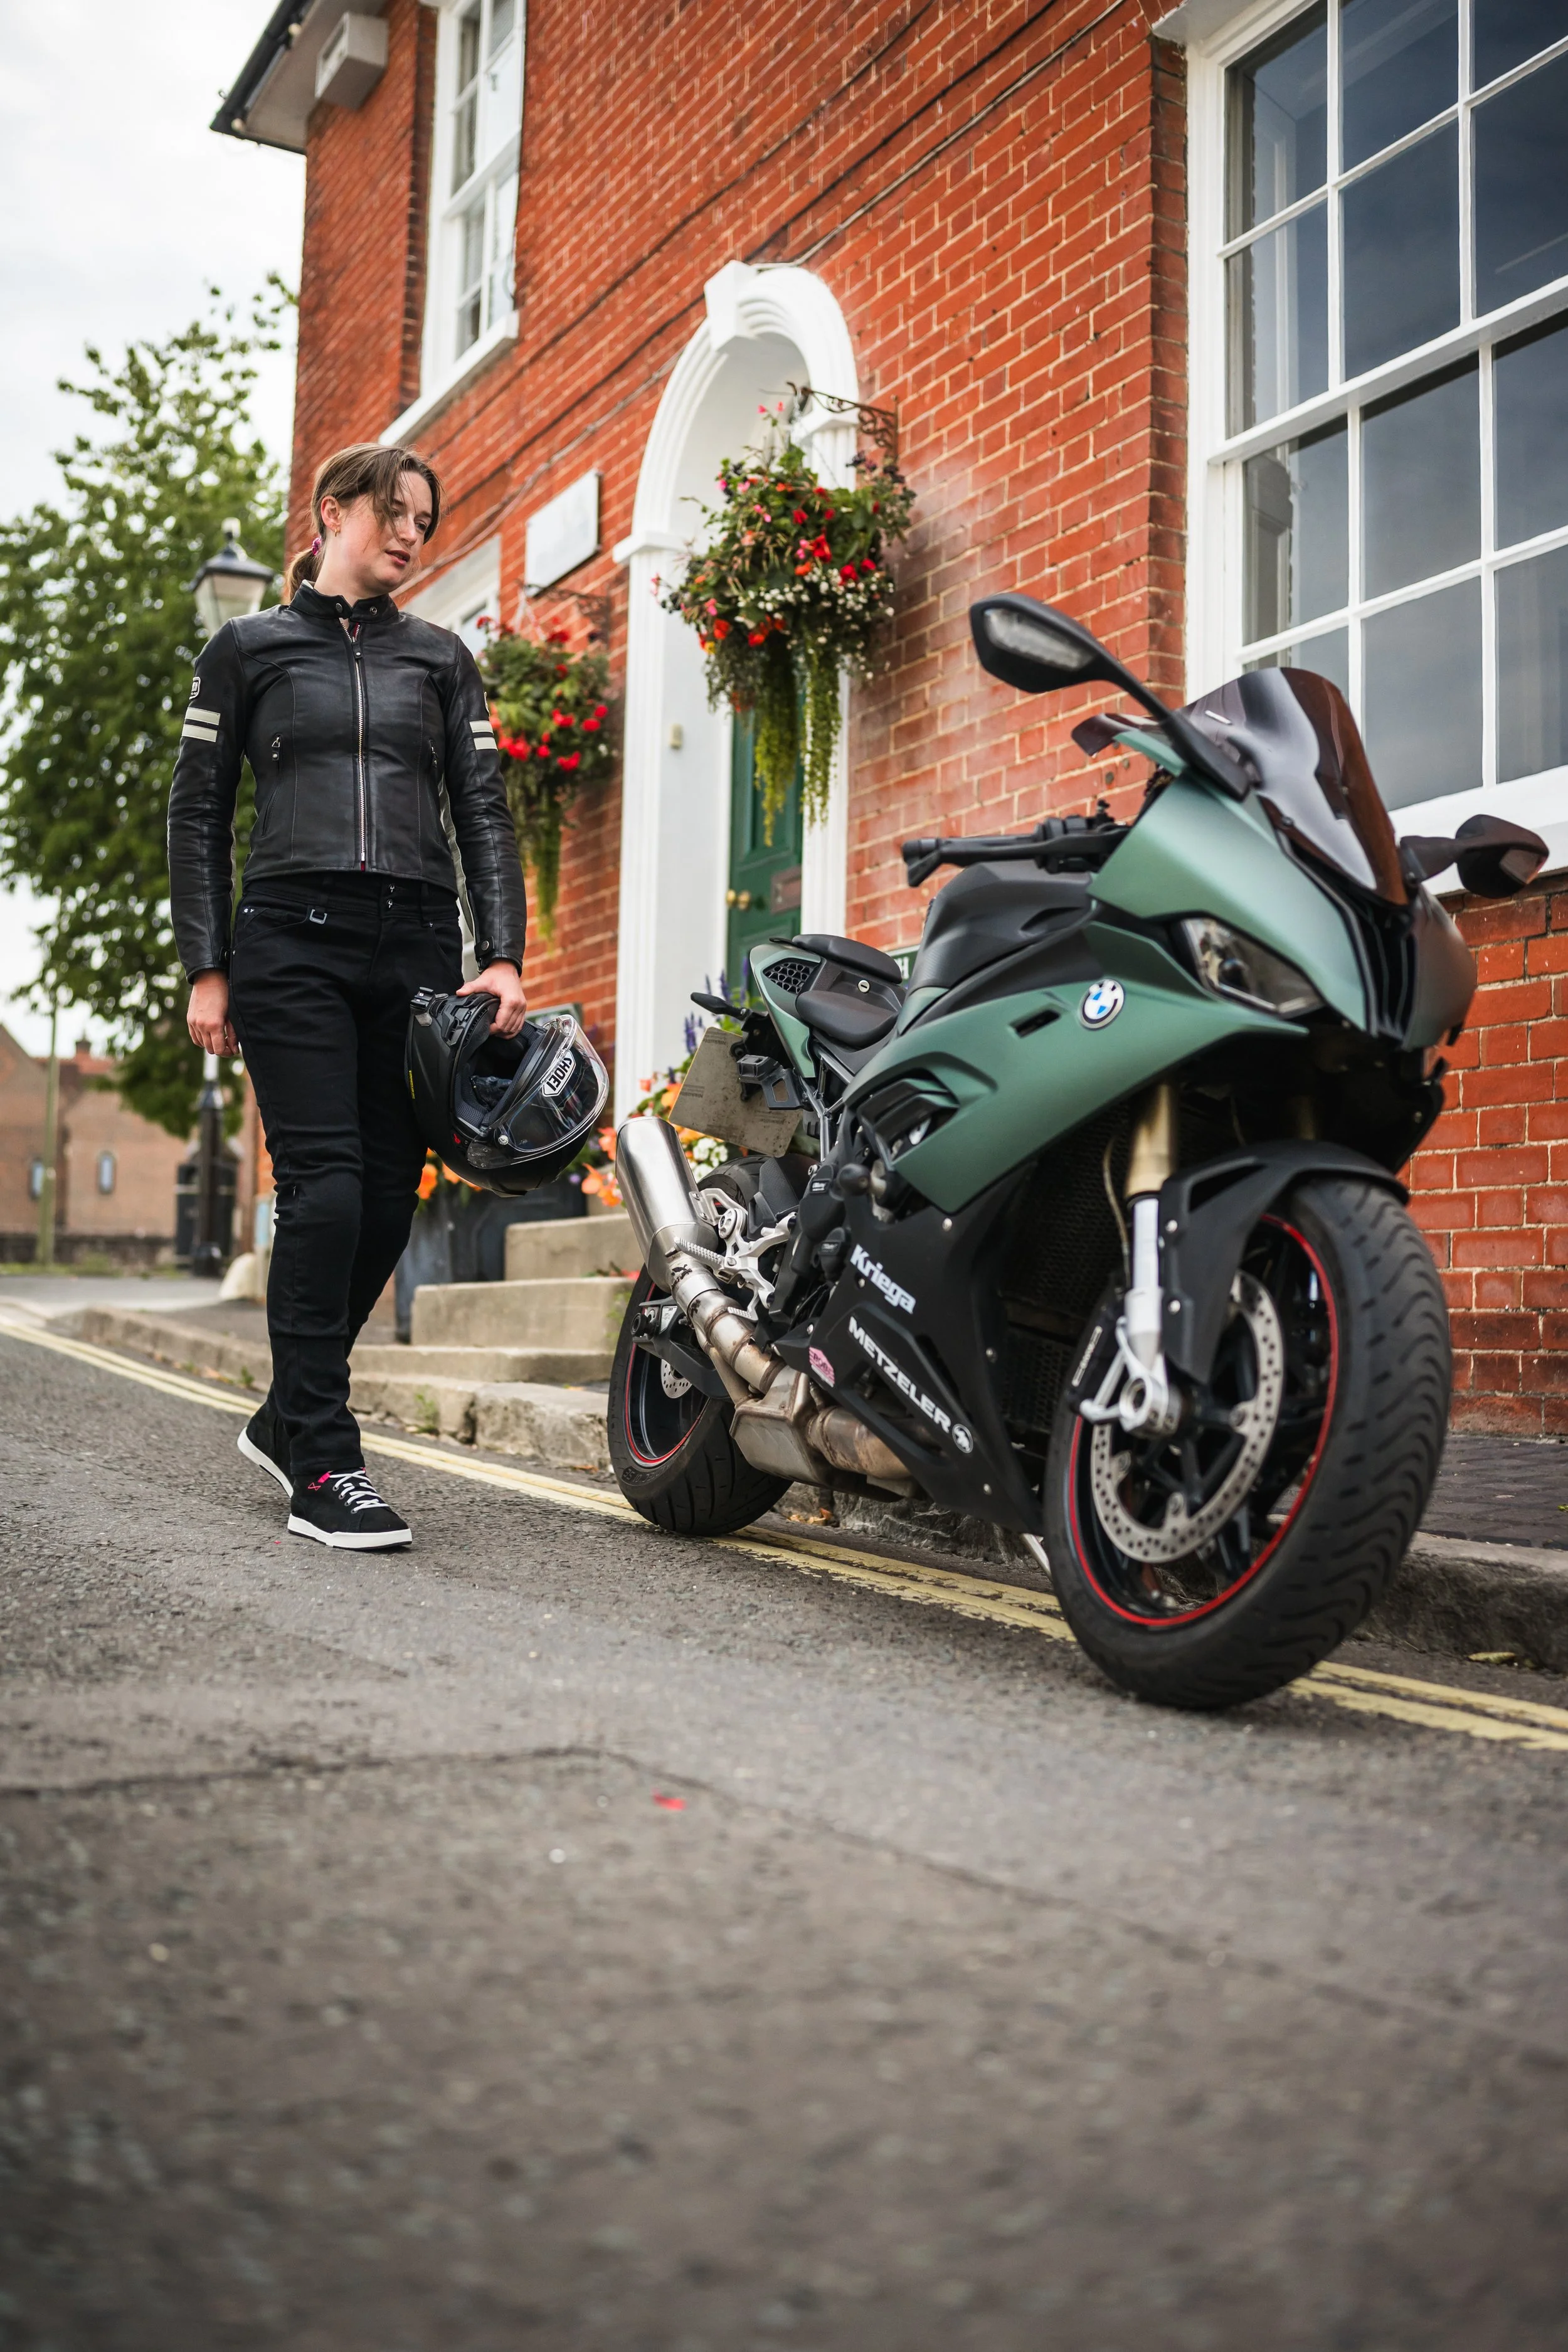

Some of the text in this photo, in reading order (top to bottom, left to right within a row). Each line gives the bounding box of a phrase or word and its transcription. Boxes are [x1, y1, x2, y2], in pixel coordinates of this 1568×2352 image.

[546, 1057, 573, 1092] SHOEI
[850, 1244, 916, 1315] Kriega
[849, 1316, 951, 1434] METZELER
